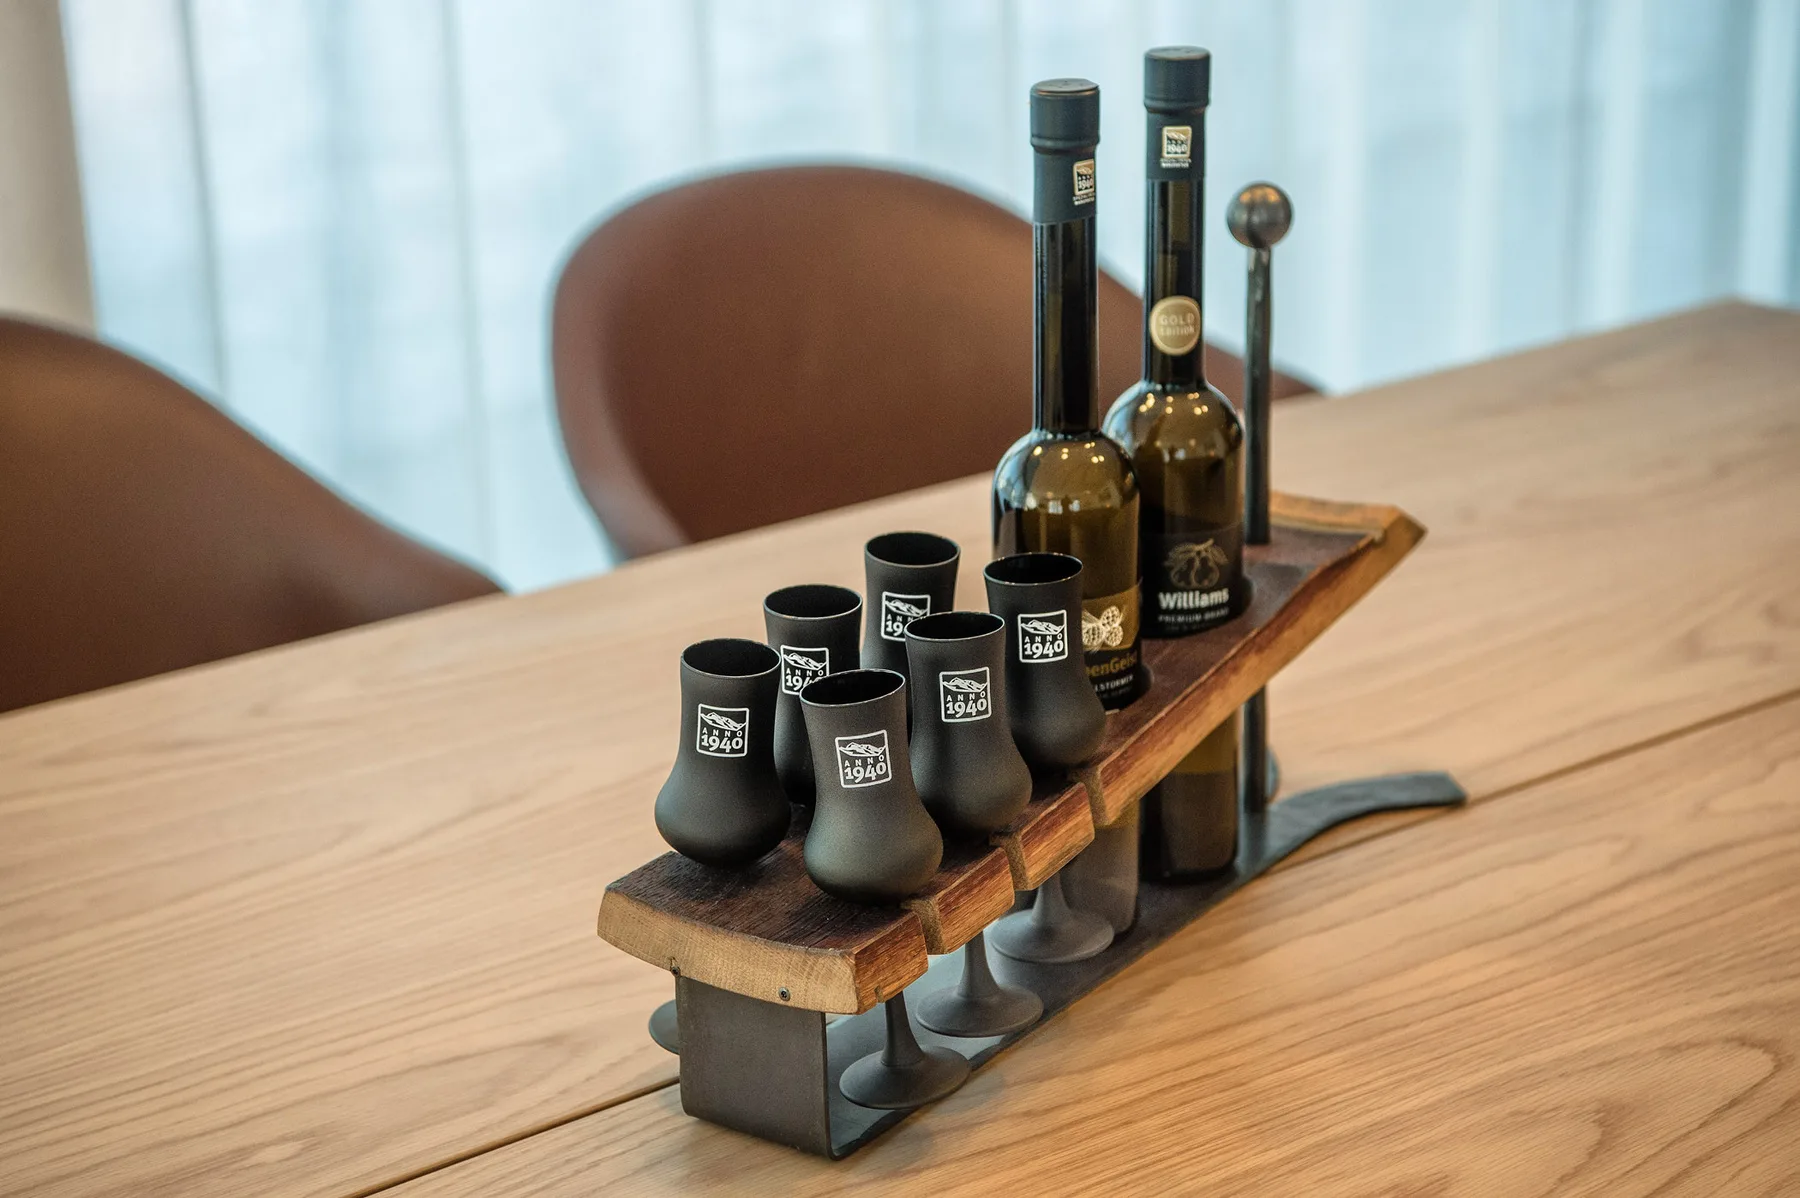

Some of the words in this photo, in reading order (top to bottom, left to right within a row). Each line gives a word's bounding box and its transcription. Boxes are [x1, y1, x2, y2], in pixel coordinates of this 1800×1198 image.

[1160, 312, 1195, 326] GOLD
[1158, 587, 1230, 610] Williams
[886, 613, 914, 623] ANN
[885, 620, 904, 637] 19
[1024, 632, 1063, 643] ANNO
[1023, 640, 1064, 659] 1940
[785, 667, 824, 677] ANNO
[785, 675, 814, 691] 194
[946, 690, 986, 702] ANNO
[945, 698, 988, 718] 1940
[702, 727, 743, 737] ANNO
[701, 734, 744, 753] 1940
[844, 754, 885, 767] ANNO
[843, 762, 887, 783] 1940
